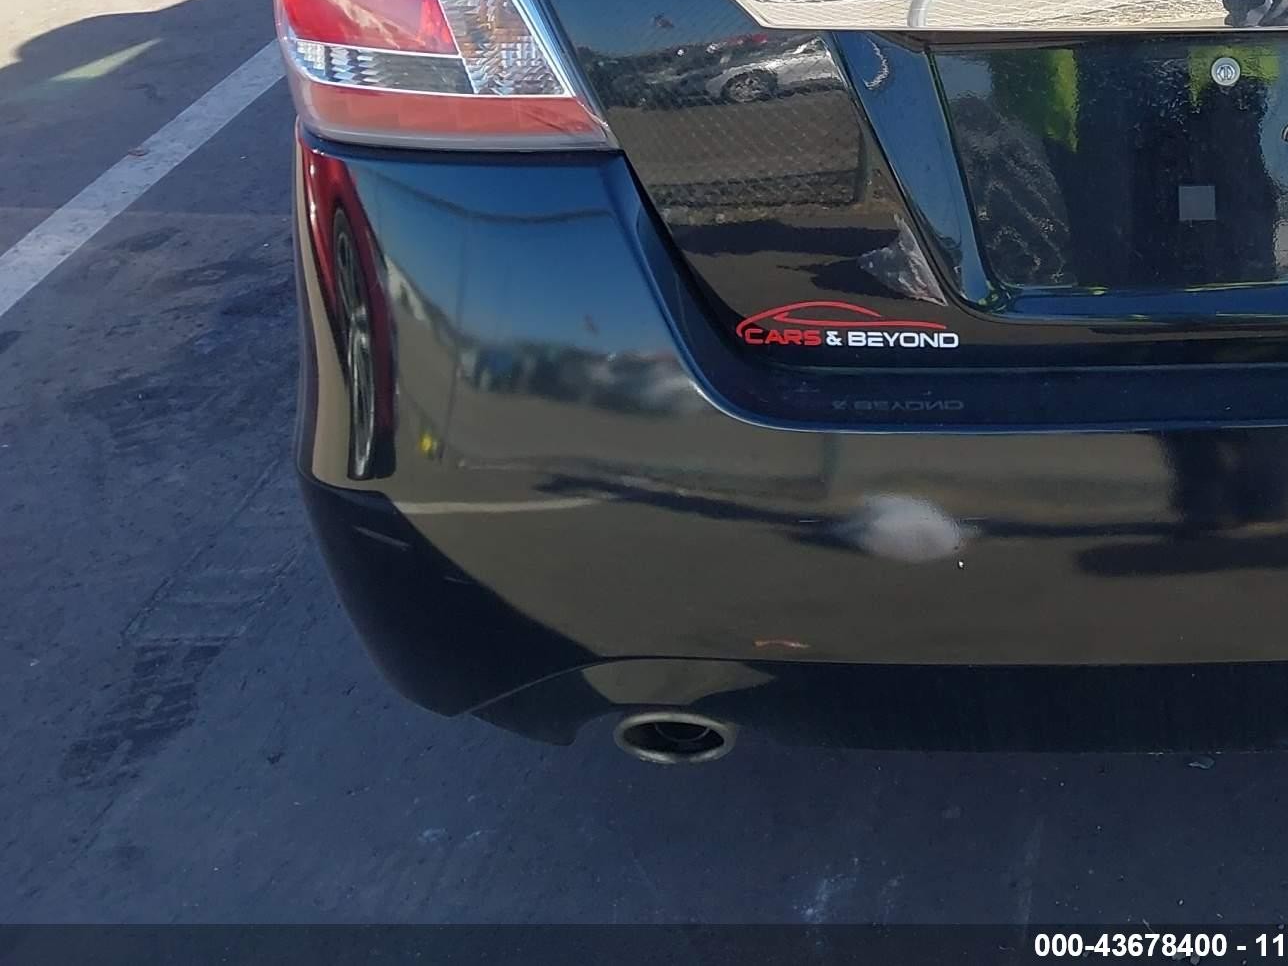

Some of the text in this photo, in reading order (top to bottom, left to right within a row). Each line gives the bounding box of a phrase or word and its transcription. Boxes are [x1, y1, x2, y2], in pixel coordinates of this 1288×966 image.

[744, 328, 960, 348] CARS & BEYOND
